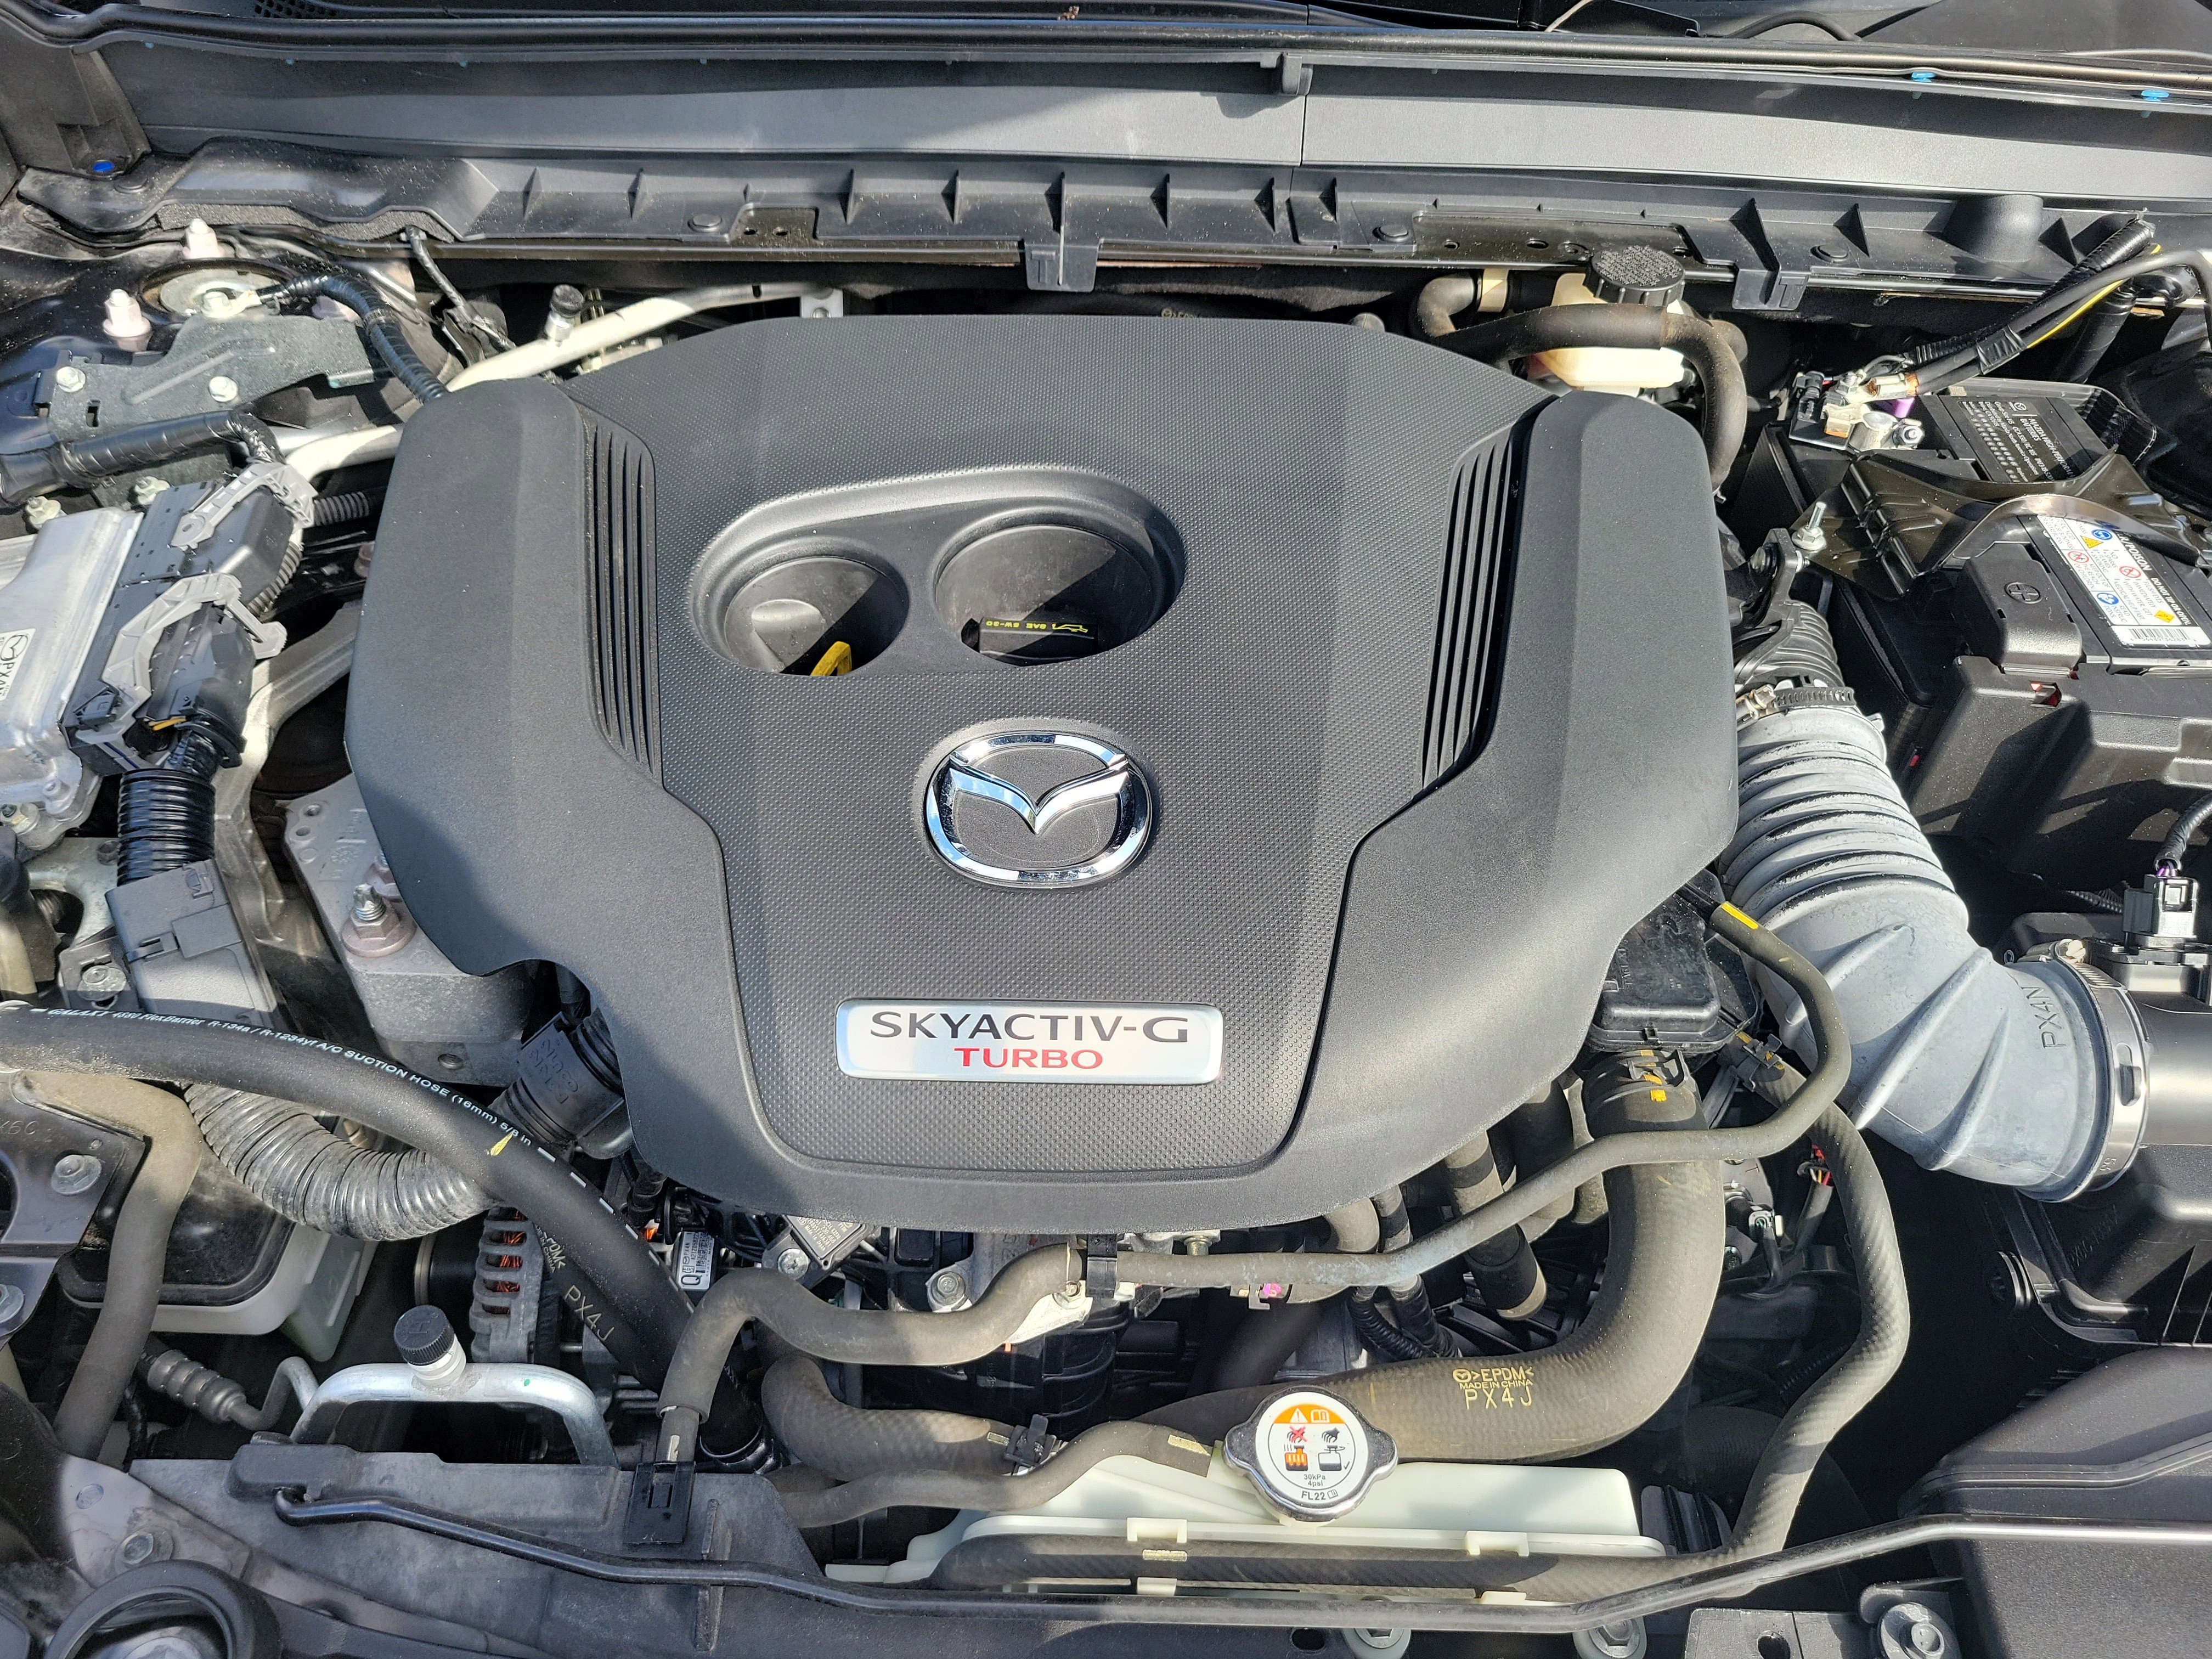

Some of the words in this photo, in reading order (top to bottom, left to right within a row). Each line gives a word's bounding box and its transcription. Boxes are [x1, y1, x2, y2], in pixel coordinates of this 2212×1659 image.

[2019, 419, 2041, 441] BATTERIES
[2157, 585, 2169, 595] NOT
[869, 1011, 1189, 1043] SKYACTIV-G
[2020, 986, 2067, 1049] PX4N
[953, 1046, 1104, 1070] TURBO
[208, 1020, 249, 1033] R-134a
[258, 1028, 318, 1047] R-1234yf
[315, 1042, 343, 1054] A/C
[343, 1049, 409, 1079] SUCTION
[409, 1074, 450, 1097] HOSE
[451, 1094, 498, 1124] (16mm)
[500, 1121, 520, 1137] 5/8
[681, 1274, 703, 1285] Q
[565, 1284, 615, 1341] PX4J
[1459, 1381, 1489, 1389] MADE
[1501, 1379, 1533, 1388] CHINA
[1301, 1490, 1327, 1500] FL22
